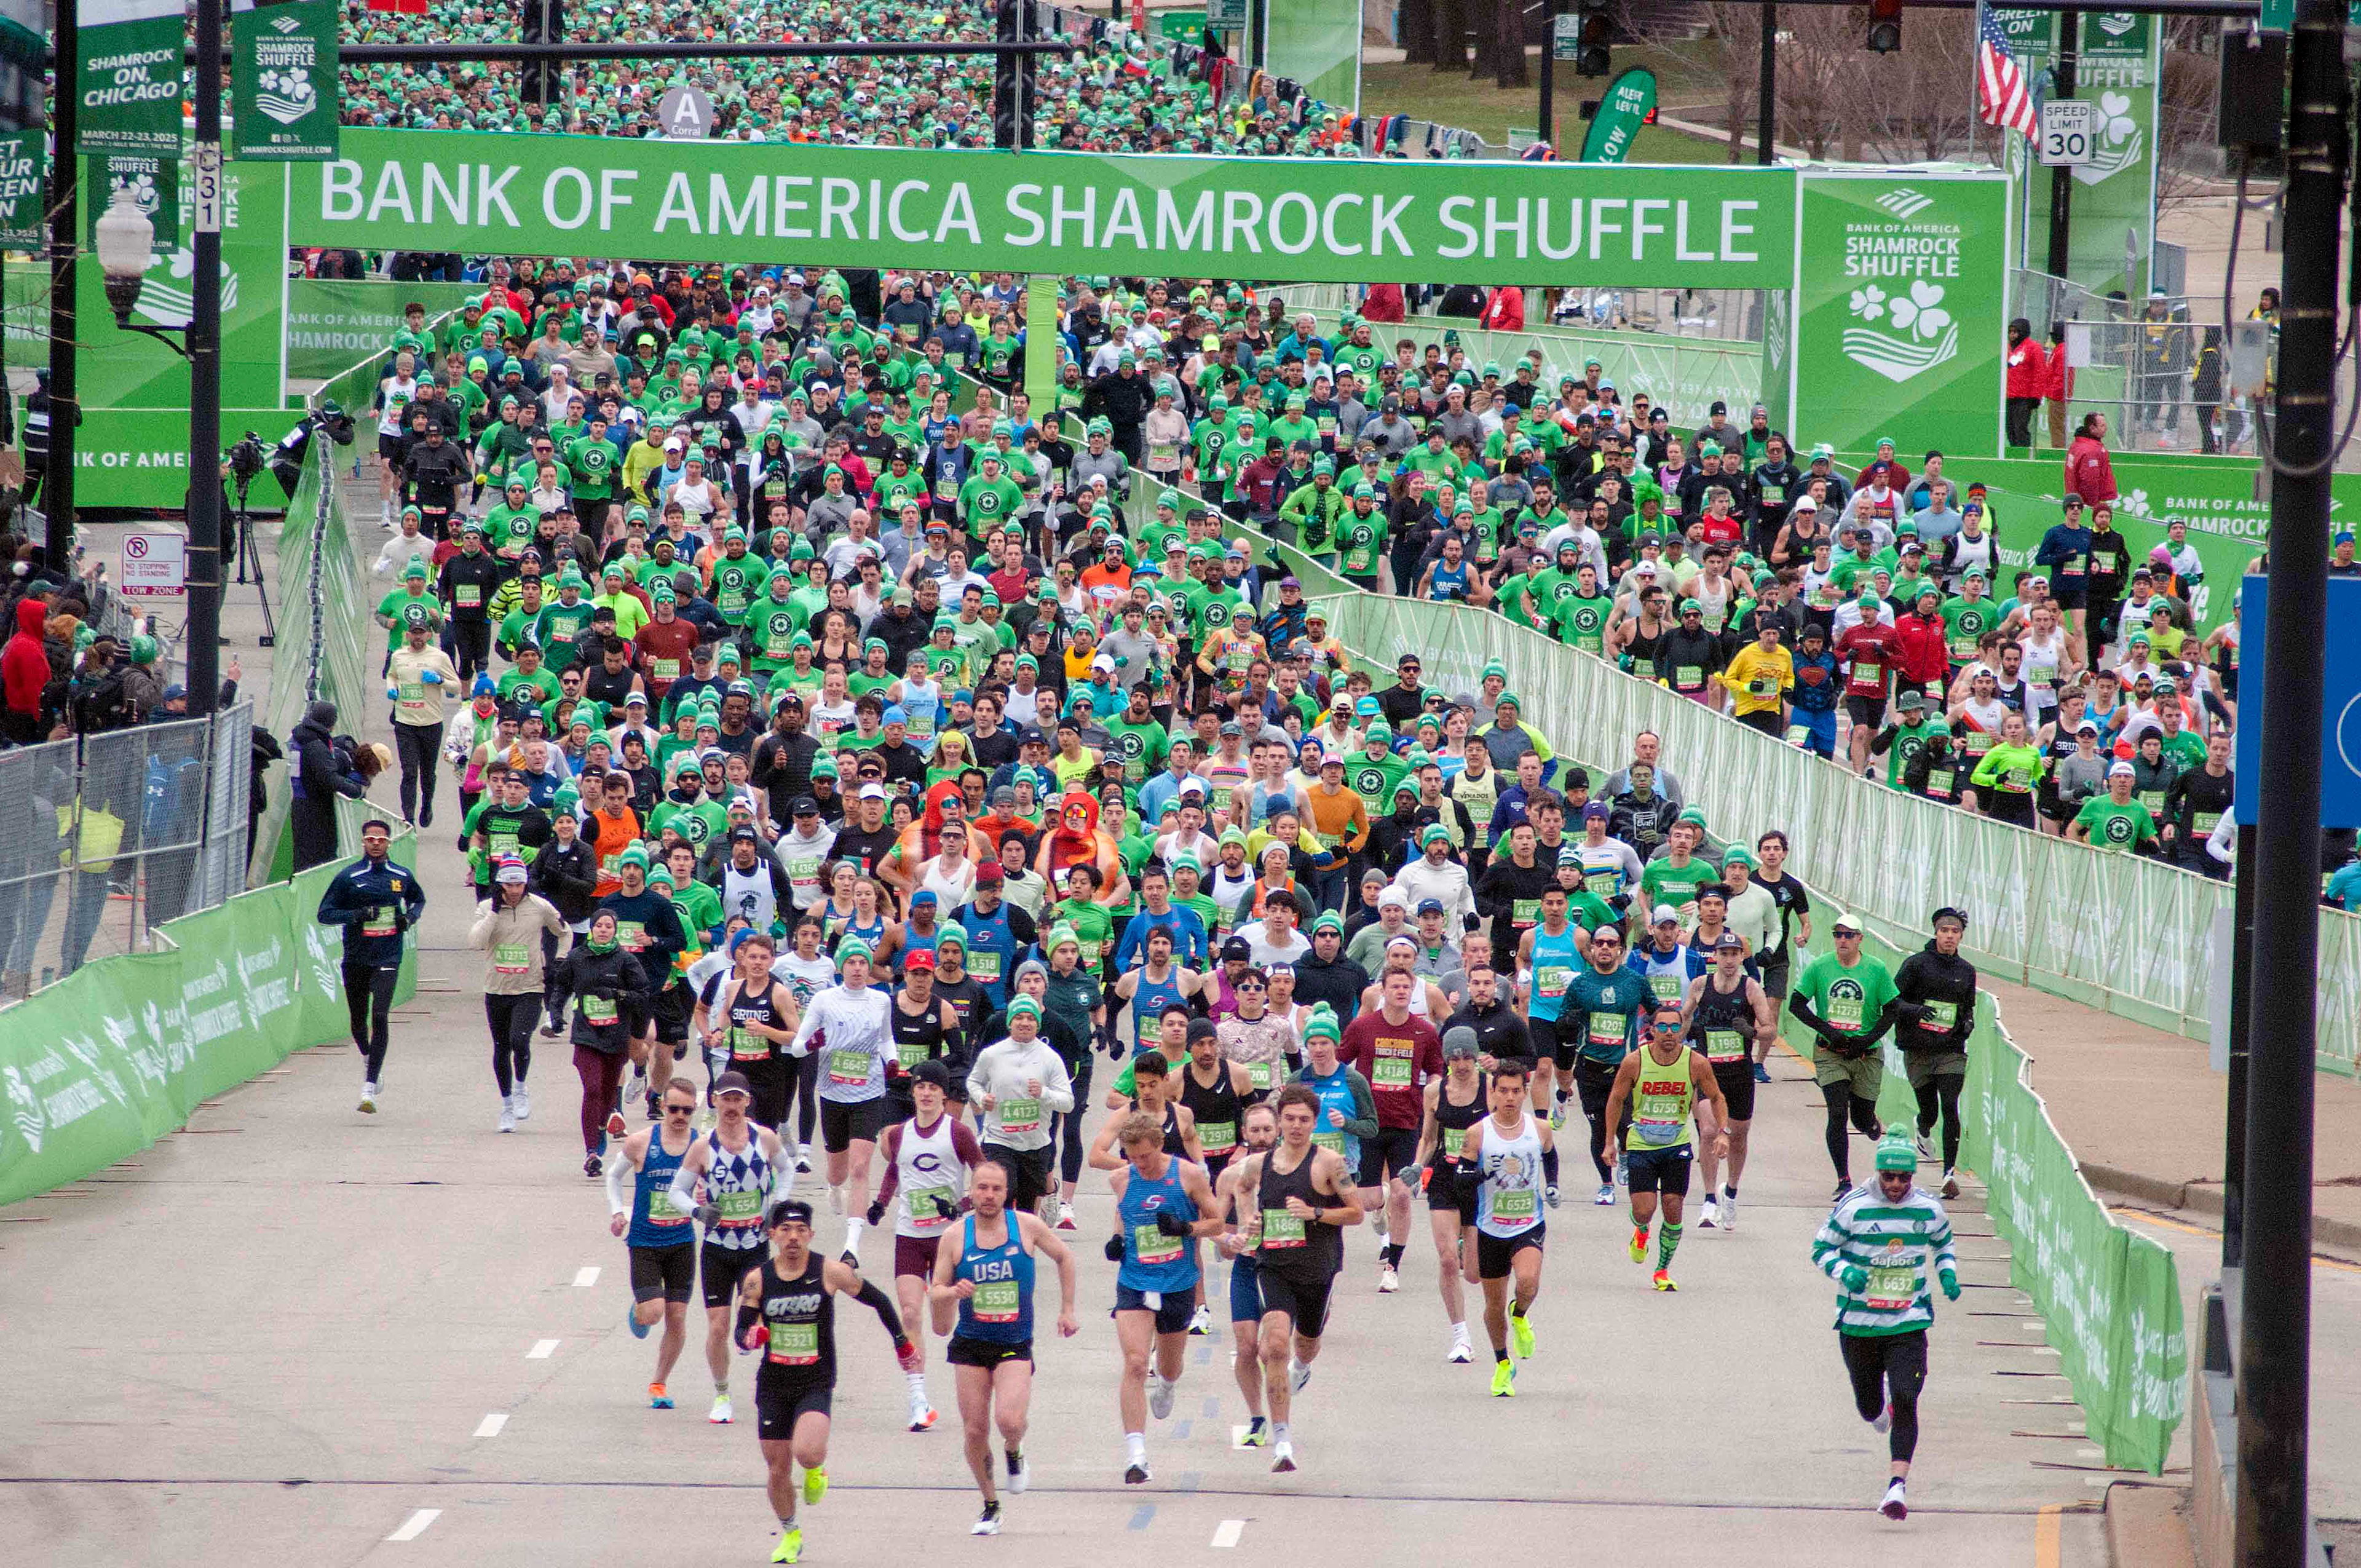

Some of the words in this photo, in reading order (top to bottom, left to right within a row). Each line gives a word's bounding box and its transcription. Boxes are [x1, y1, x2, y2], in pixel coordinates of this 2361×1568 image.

[2008, 20, 2033, 33] ON
[256, 44, 315, 53] SHAMROCK
[87, 49, 173, 71] SHAMROCK
[256, 53, 315, 66] SHUFFLE
[114, 66, 151, 85] ON,
[2078, 68, 2143, 87] UFFLE
[84, 81, 178, 106] CHICAGO
[674, 93, 700, 124] A
[2046, 107, 2088, 116] SPEED
[671, 125, 700, 136] Corral
[2050, 120, 2083, 129] LIMIT
[82, 130, 119, 139] MARCH
[152, 133, 178, 142] 2025
[2048, 133, 2085, 156] 30
[108, 162, 159, 173] SHUFFLE
[322, 159, 521, 227] BANK
[542, 166, 639, 230] OF
[653, 172, 983, 244] AMERICA
[1003, 183, 1415, 257] SHAMROCK
[1438, 195, 1759, 263] SHUFFLE
[1847, 224, 1869, 232] BANK
[1903, 224, 1960, 234] AMERICA
[1846, 237, 1960, 255] SHAMROCK
[1845, 255, 1960, 277] SHUFFLE
[325, 314, 345, 325] OF
[287, 332, 384, 349] HAMROCK
[101, 452, 130, 463] OF
[2166, 497, 2208, 510] BANK
[2212, 499, 2233, 510] OF
[126, 586, 148, 595] TOW
[152, 586, 180, 595] ZONE
[978, 958, 995, 969] 518
[1659, 981, 1677, 993] 673
[1375, 1066, 1383, 1077] A
[1642, 1080, 1688, 1096] REBEL
[1642, 1103, 1650, 1114] A
[1652, 1102, 1677, 1114] 6750
[1496, 1198, 1504, 1210] A
[1506, 1198, 1532, 1211] 6523
[973, 1261, 1013, 1283] USA
